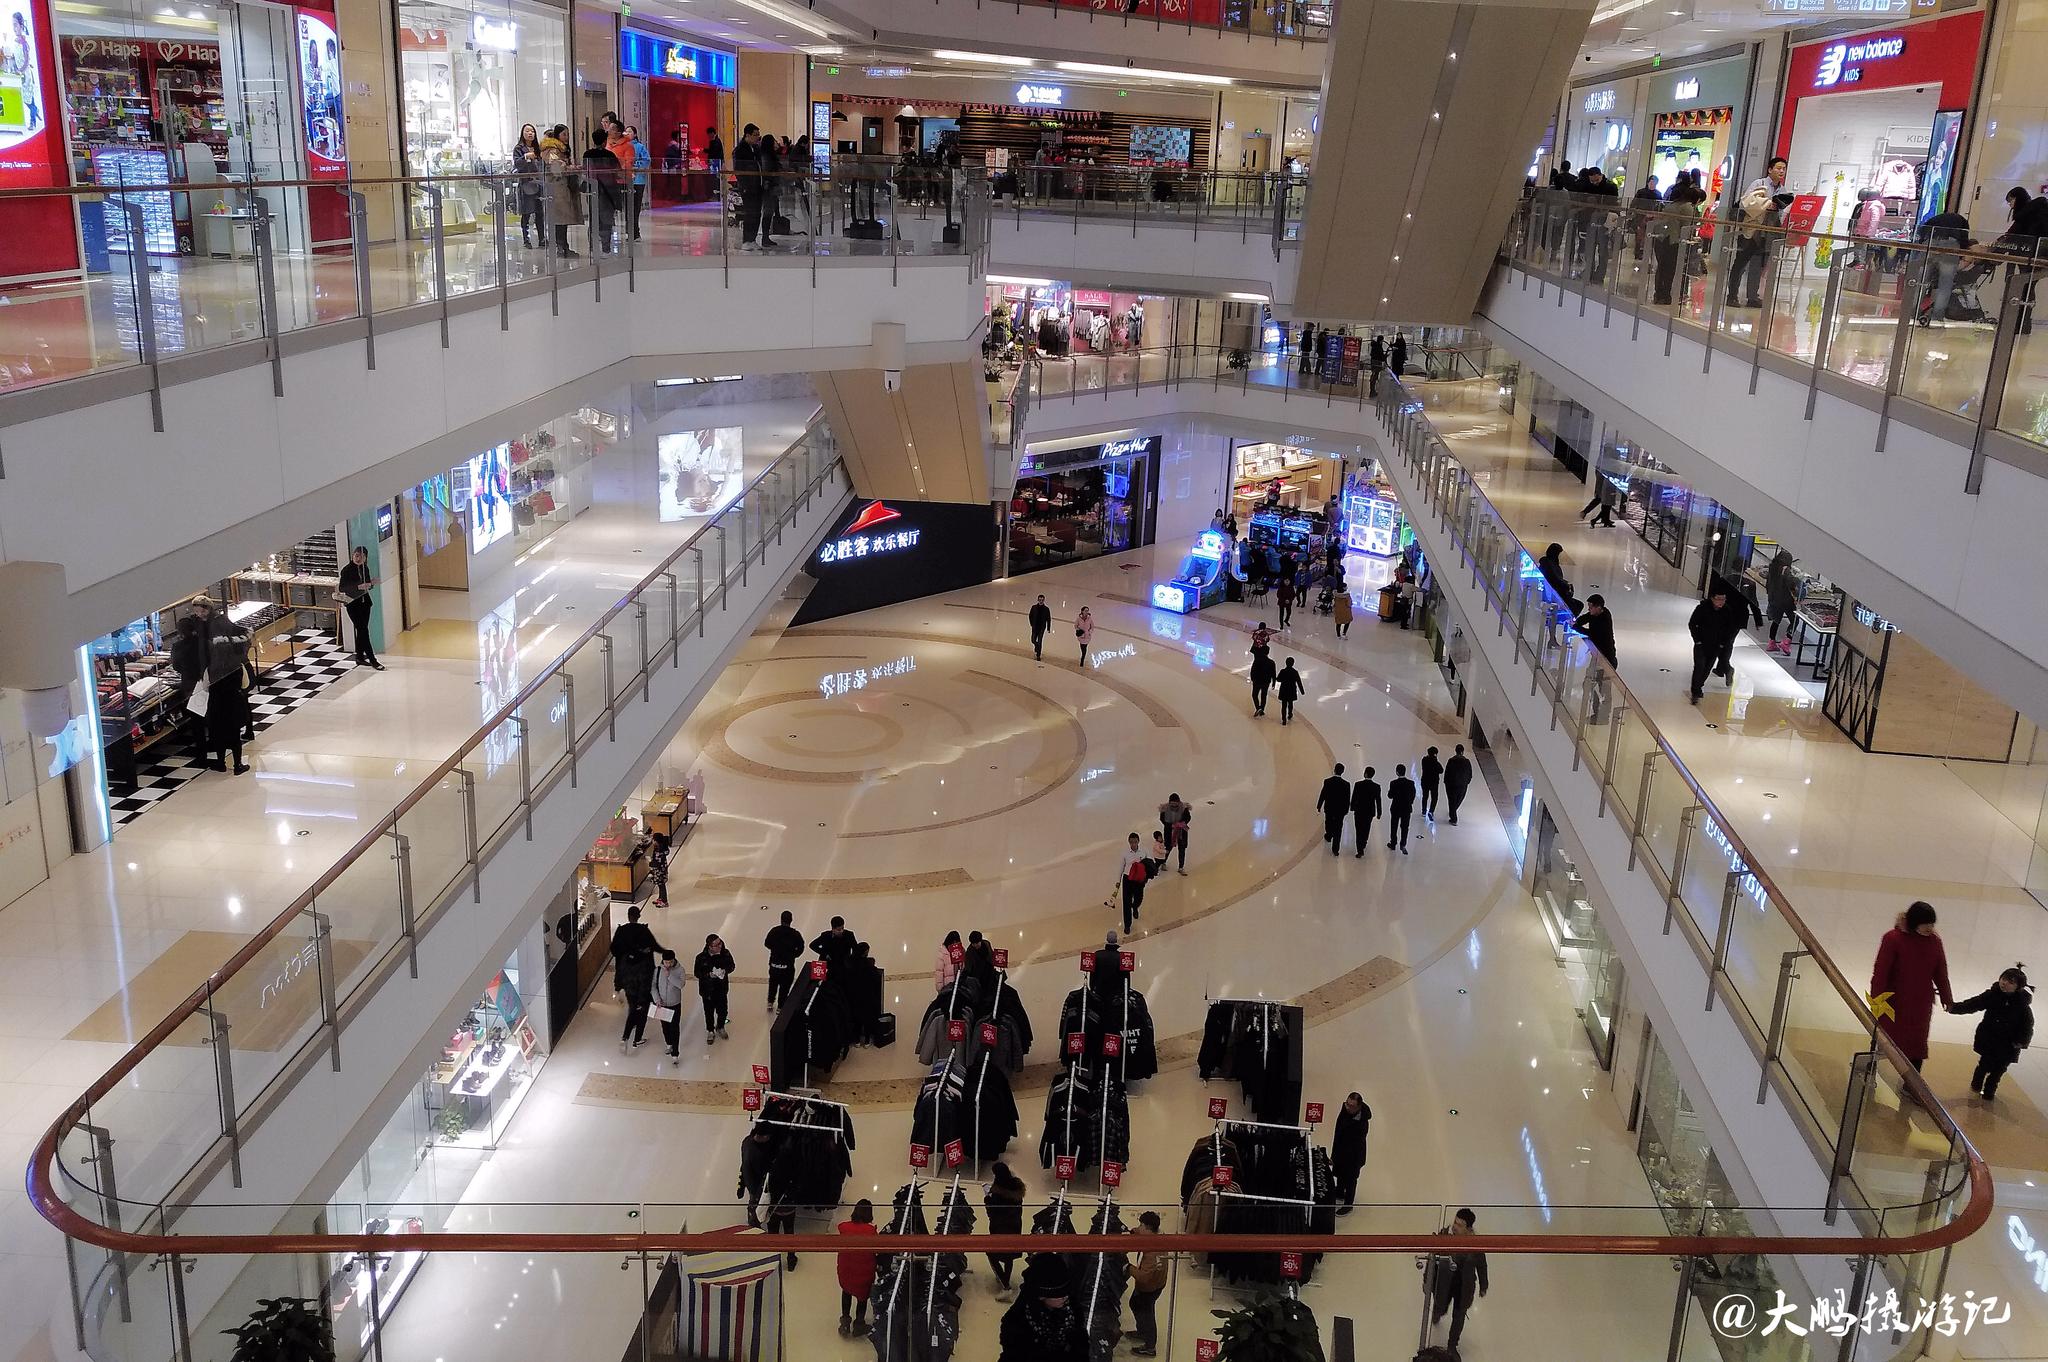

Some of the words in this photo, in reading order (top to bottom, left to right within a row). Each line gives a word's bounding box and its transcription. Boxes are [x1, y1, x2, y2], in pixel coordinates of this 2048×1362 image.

[100, 40, 141, 61] Hape
[188, 44, 219, 63] Hap
[1847, 45, 1866, 62] new
[1866, 38, 1903, 59] balance
[1844, 68, 1860, 82] KIDS
[1906, 135, 1930, 143] KIDS
[1101, 442, 1129, 459] Pizza
[1129, 438, 1151, 453] Hut
[820, 536, 870, 563] 必胜客
[872, 529, 920, 553] 欢乐餐厅
[983, 1029, 995, 1040] 50%
[745, 1096, 758, 1104] 50%
[1211, 1105, 1224, 1113] 50%
[912, 1152, 926, 1161] 50%
[949, 1150, 961, 1161] 50%
[1059, 1165, 1072, 1173] 50%
[1104, 1170, 1118, 1179] 50%
[1283, 1261, 1298, 1270] 50%
[1199, 1347, 1215, 1357] 50%
